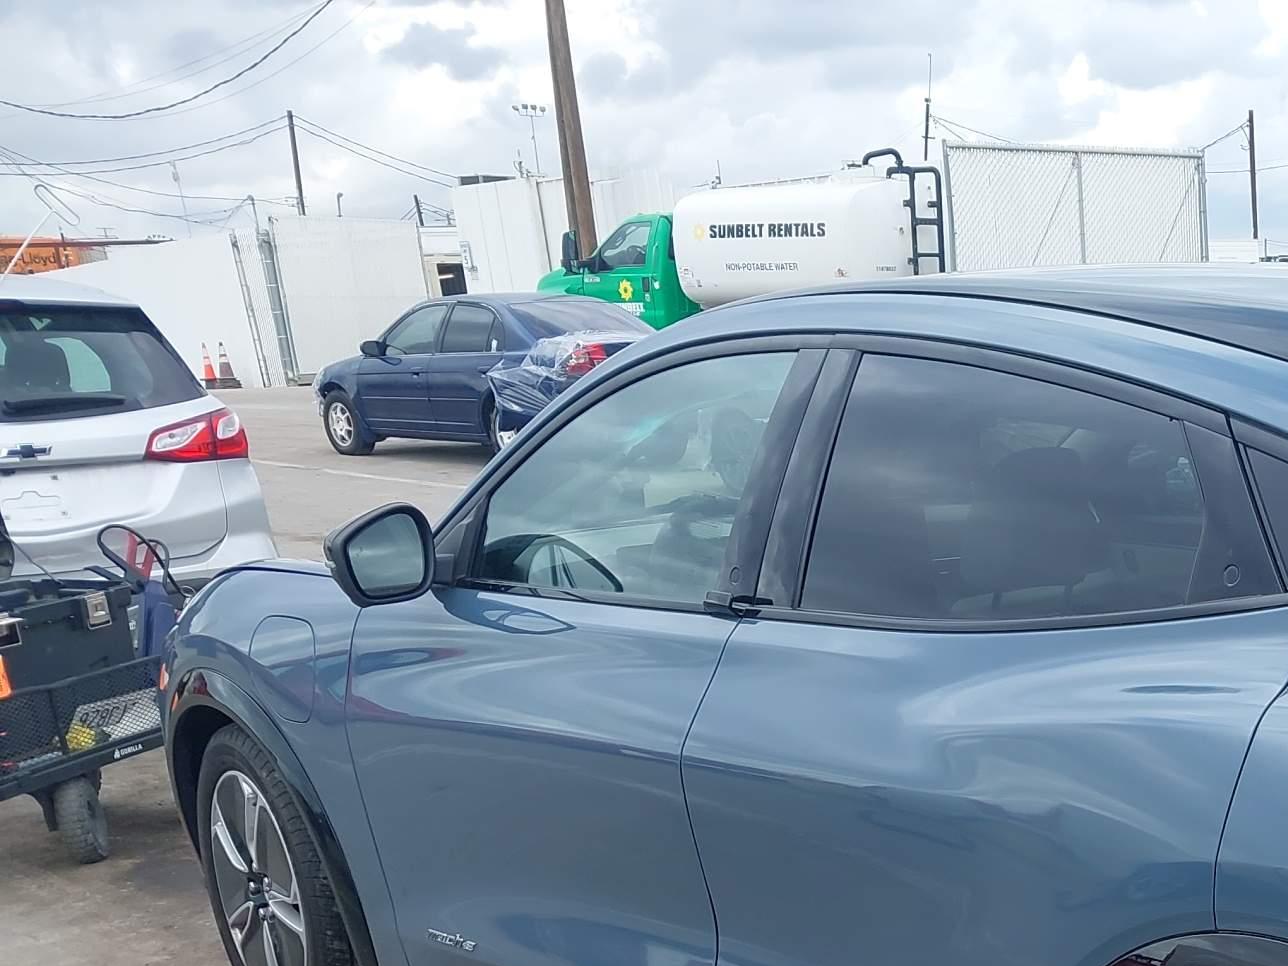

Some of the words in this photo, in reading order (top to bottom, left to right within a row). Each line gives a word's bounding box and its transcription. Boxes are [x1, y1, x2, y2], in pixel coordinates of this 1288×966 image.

[709, 223, 764, 239] SUNBELT
[768, 222, 826, 237] RENTALS
[725, 262, 774, 272] NON-POTABLE
[775, 262, 799, 272] WATER
